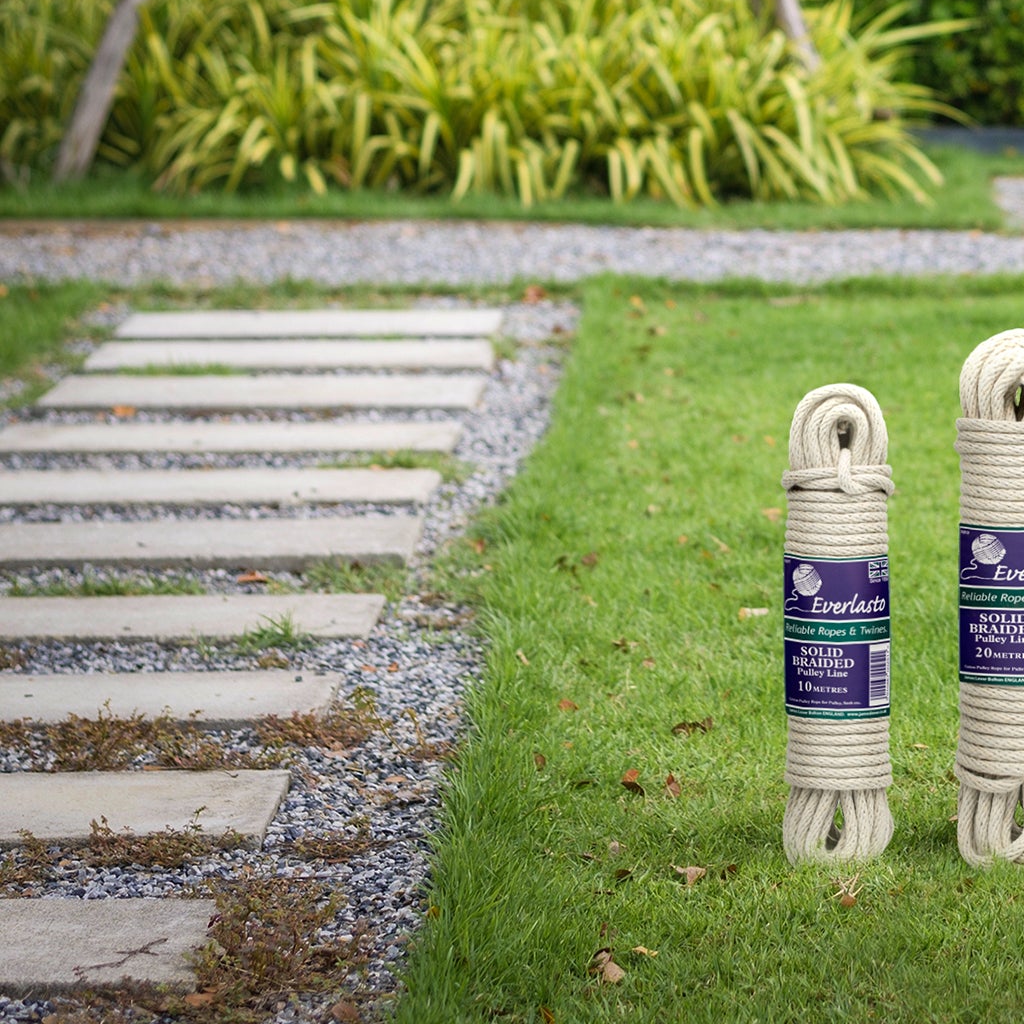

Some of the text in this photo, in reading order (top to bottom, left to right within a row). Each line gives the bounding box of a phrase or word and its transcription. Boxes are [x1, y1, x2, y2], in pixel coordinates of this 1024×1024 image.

[961, 592, 997, 601] Reliable
[811, 593, 885, 614] Everlasto
[786, 623, 815, 635] Reliable
[818, 626, 846, 637] Ropes
[849, 627, 856, 636] &
[975, 634, 1007, 645] Pulley
[800, 646, 843, 657] SOLID
[975, 647, 992, 658] 20
[792, 656, 855, 668] BRAIDED
[797, 667, 848, 678] Pulley Line
[798, 681, 812, 692] 10
